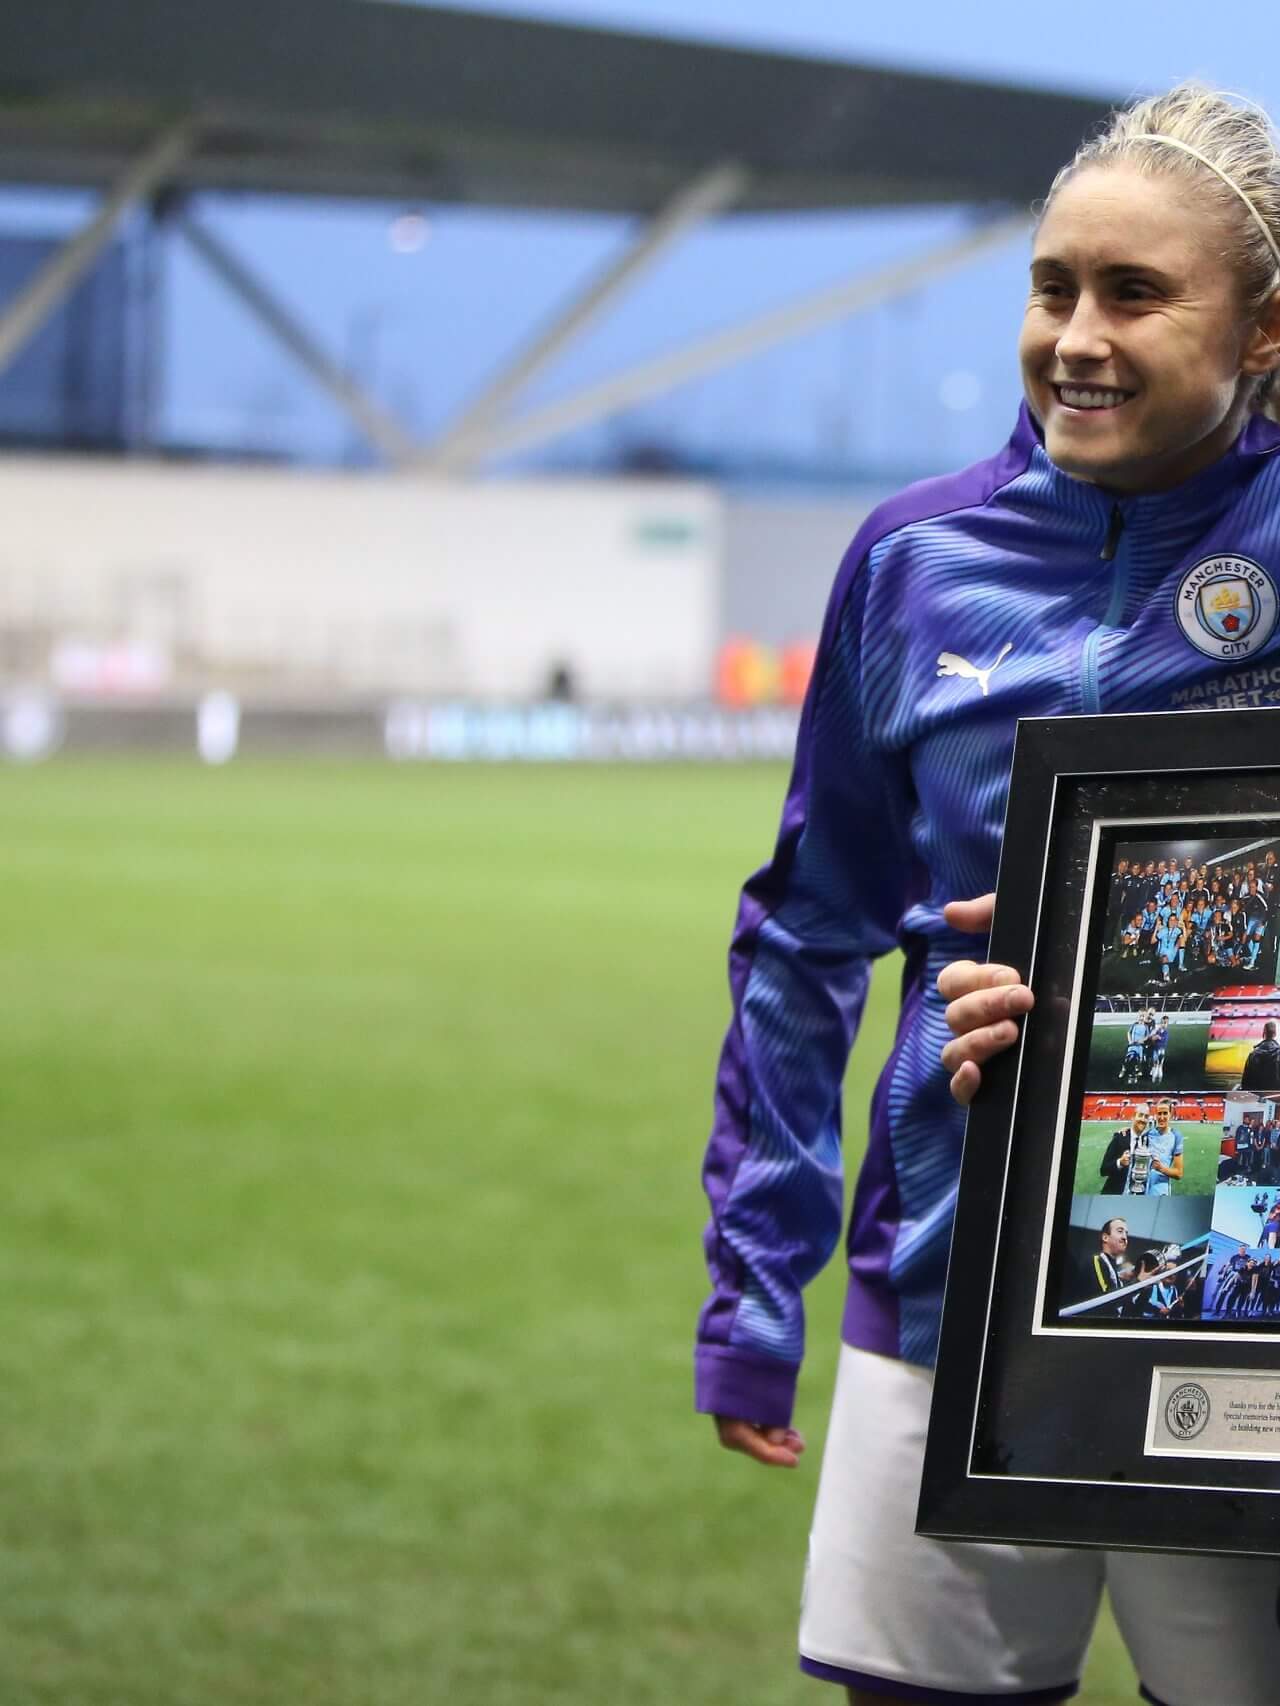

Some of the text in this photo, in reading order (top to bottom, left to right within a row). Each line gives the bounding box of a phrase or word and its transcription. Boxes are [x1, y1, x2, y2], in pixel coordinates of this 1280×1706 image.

[1183, 561, 1265, 600] MANCHESTER
[1221, 641, 1251, 656] CITY
[1216, 689, 1263, 710] BET
[1237, 1423, 1261, 1434] building
